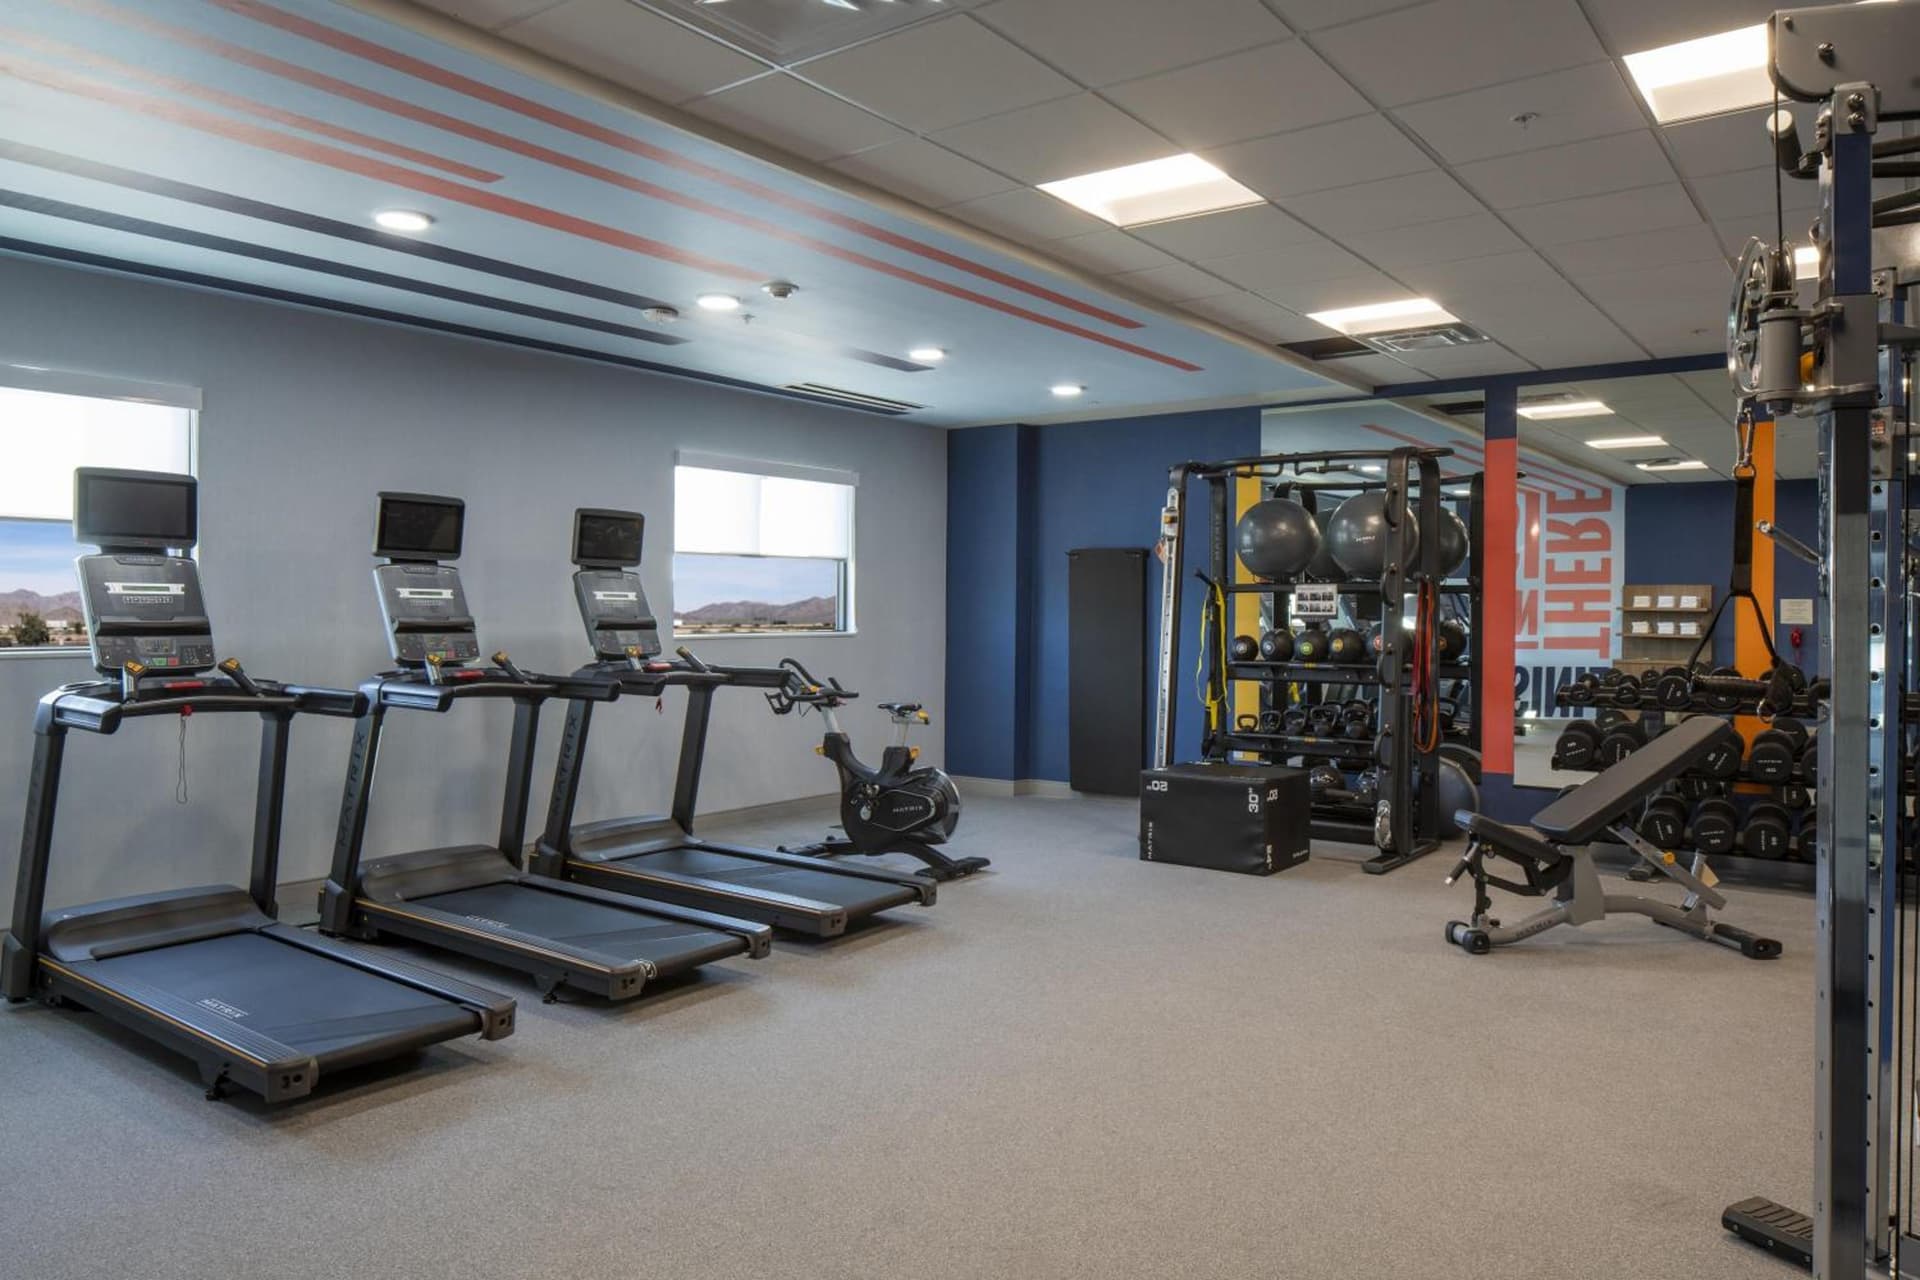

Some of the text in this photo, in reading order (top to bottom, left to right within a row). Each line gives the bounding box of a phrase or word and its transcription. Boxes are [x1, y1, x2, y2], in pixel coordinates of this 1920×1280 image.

[338, 730, 365, 847] MATRIX
[1248, 787, 1259, 813] 30"
[199, 999, 246, 1019] MATRIX
